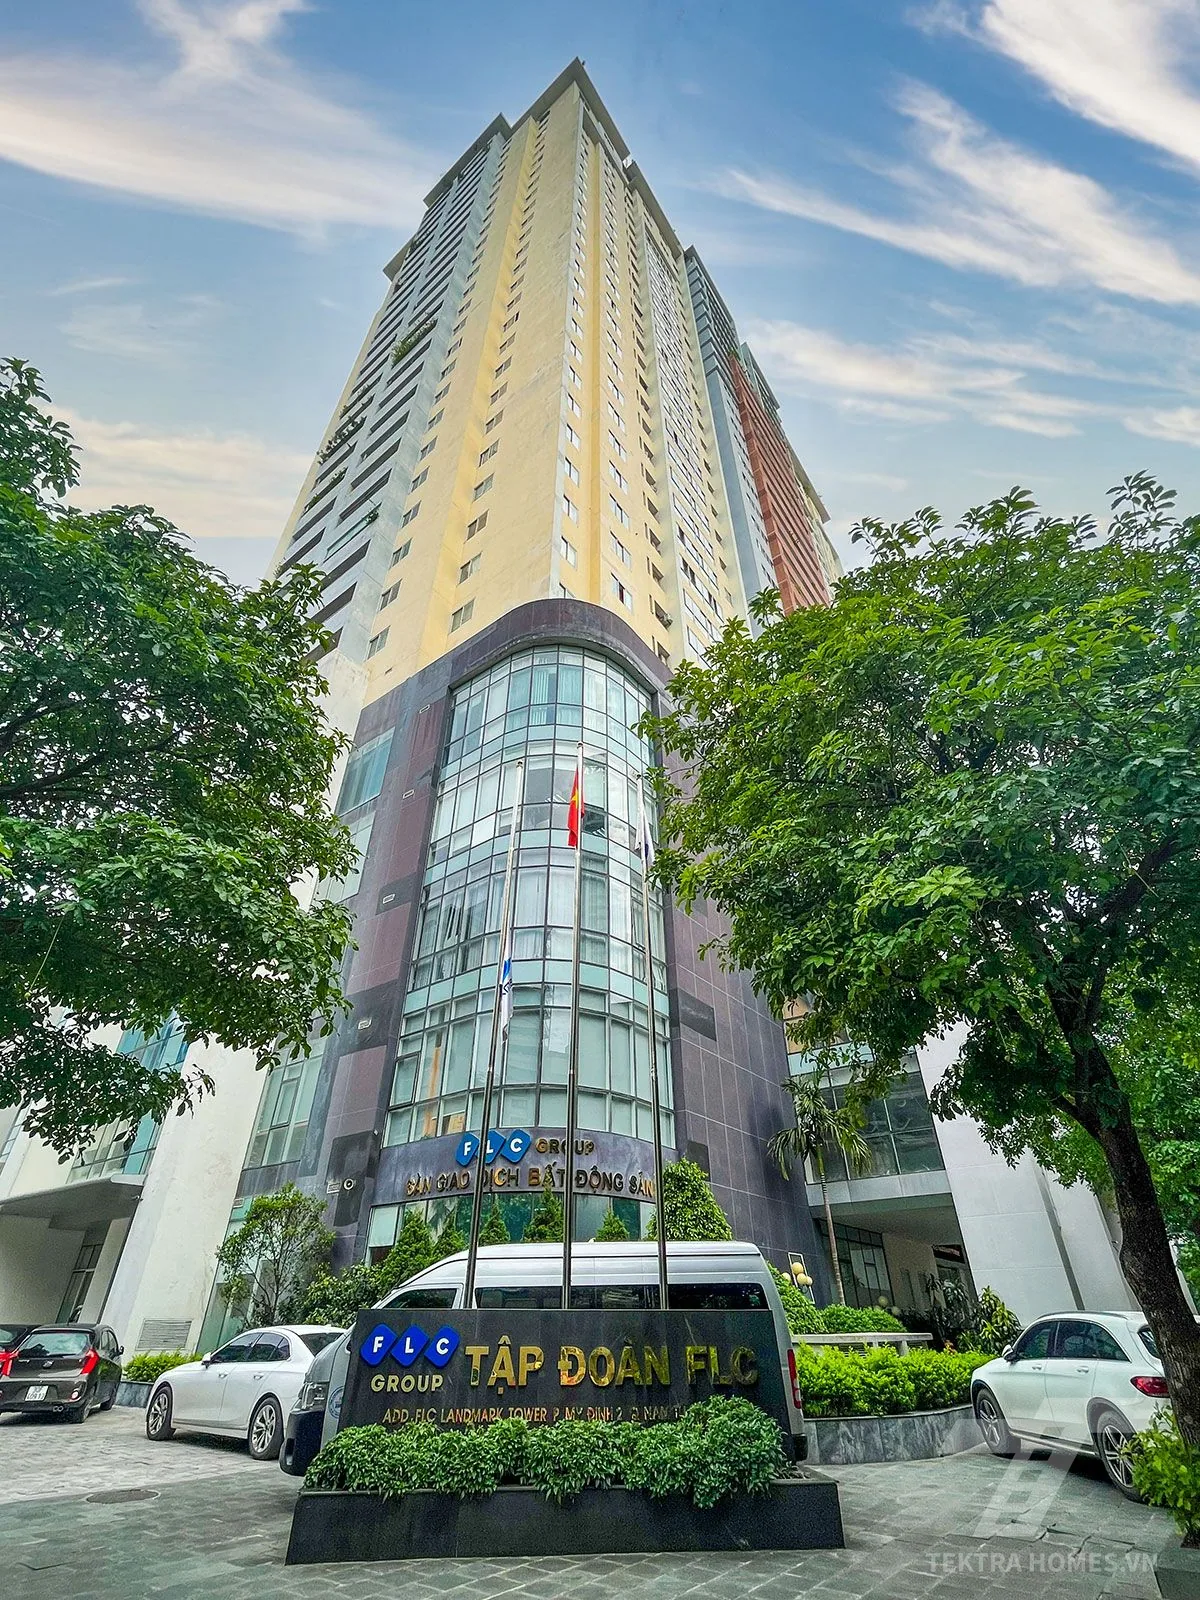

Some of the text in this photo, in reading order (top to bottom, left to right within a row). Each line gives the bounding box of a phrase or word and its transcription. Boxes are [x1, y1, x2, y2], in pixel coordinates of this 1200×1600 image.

[436, 1169, 472, 1193] GIAO
[574, 1165, 625, 1194] ĐỘNG
[464, 1334, 760, 1396] TẬP ĐOÀN FLC
[370, 1374, 444, 1394] GROUP
[440, 1405, 504, 1423] LANDMARK
[508, 1405, 548, 1421] TOWER
